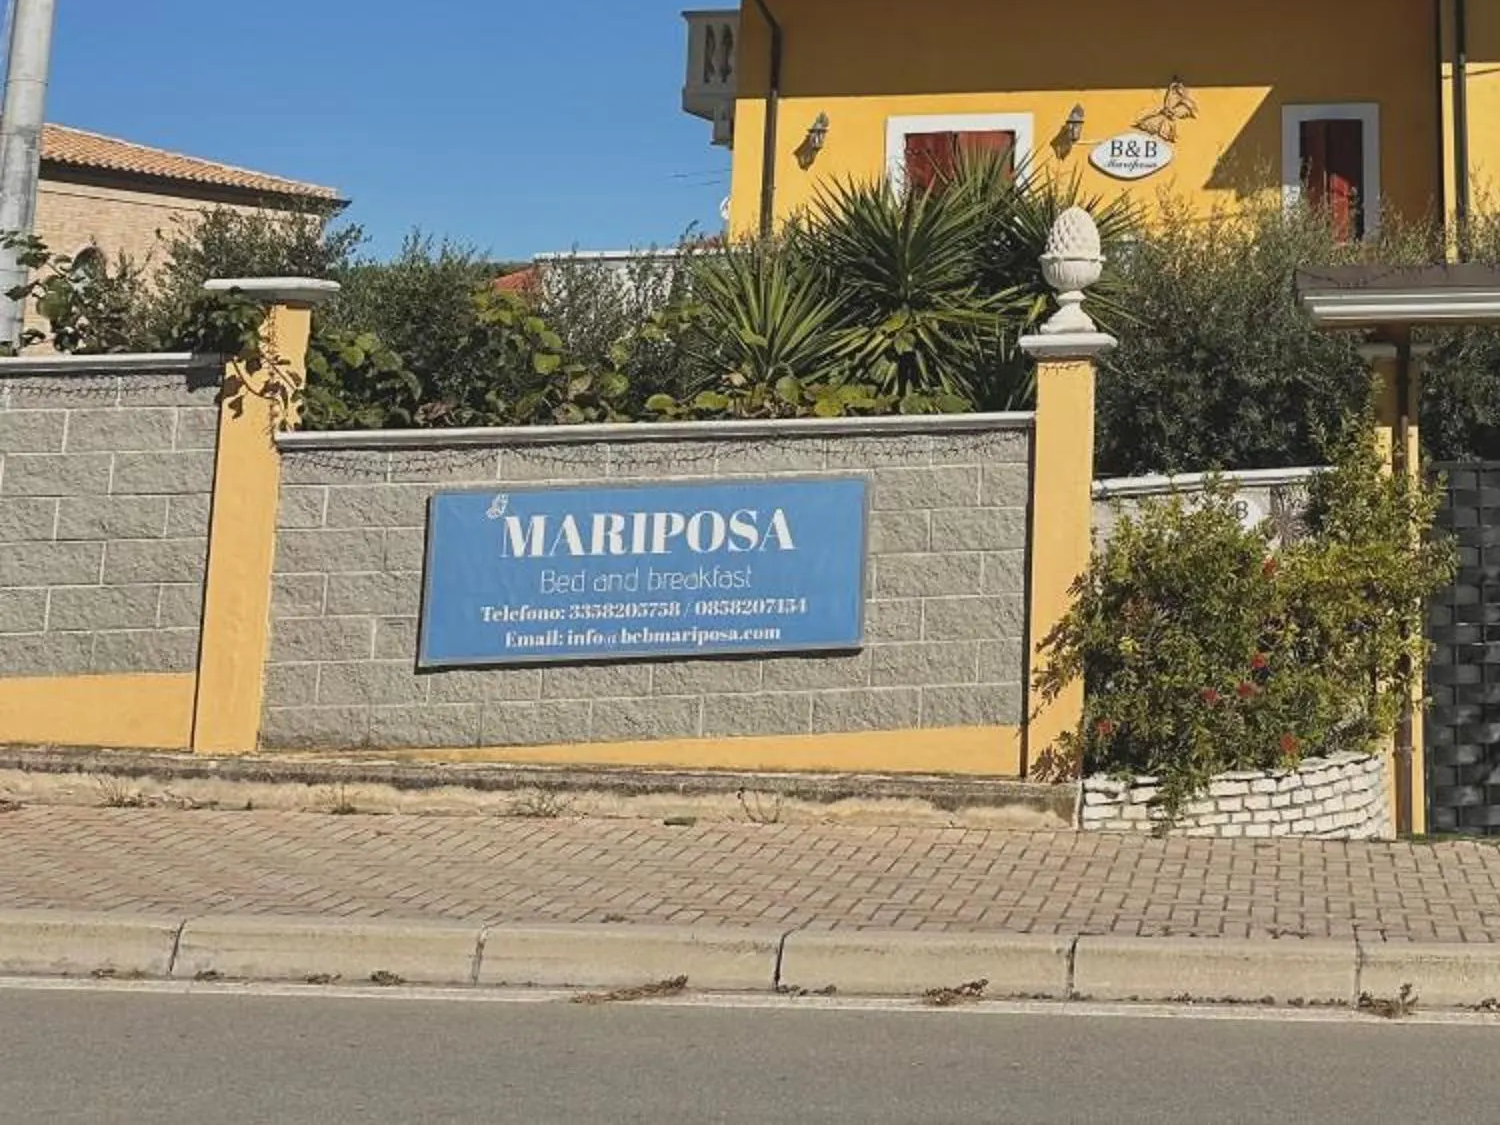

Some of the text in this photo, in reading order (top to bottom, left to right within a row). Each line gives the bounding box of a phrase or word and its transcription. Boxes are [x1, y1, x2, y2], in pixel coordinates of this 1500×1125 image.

[1110, 140, 1157, 157] B&B
[501, 507, 796, 558] MARIPOSA
[539, 564, 753, 595] Bed and breakfast
[479, 604, 566, 623] Telefono:
[504, 628, 564, 648] Email:
